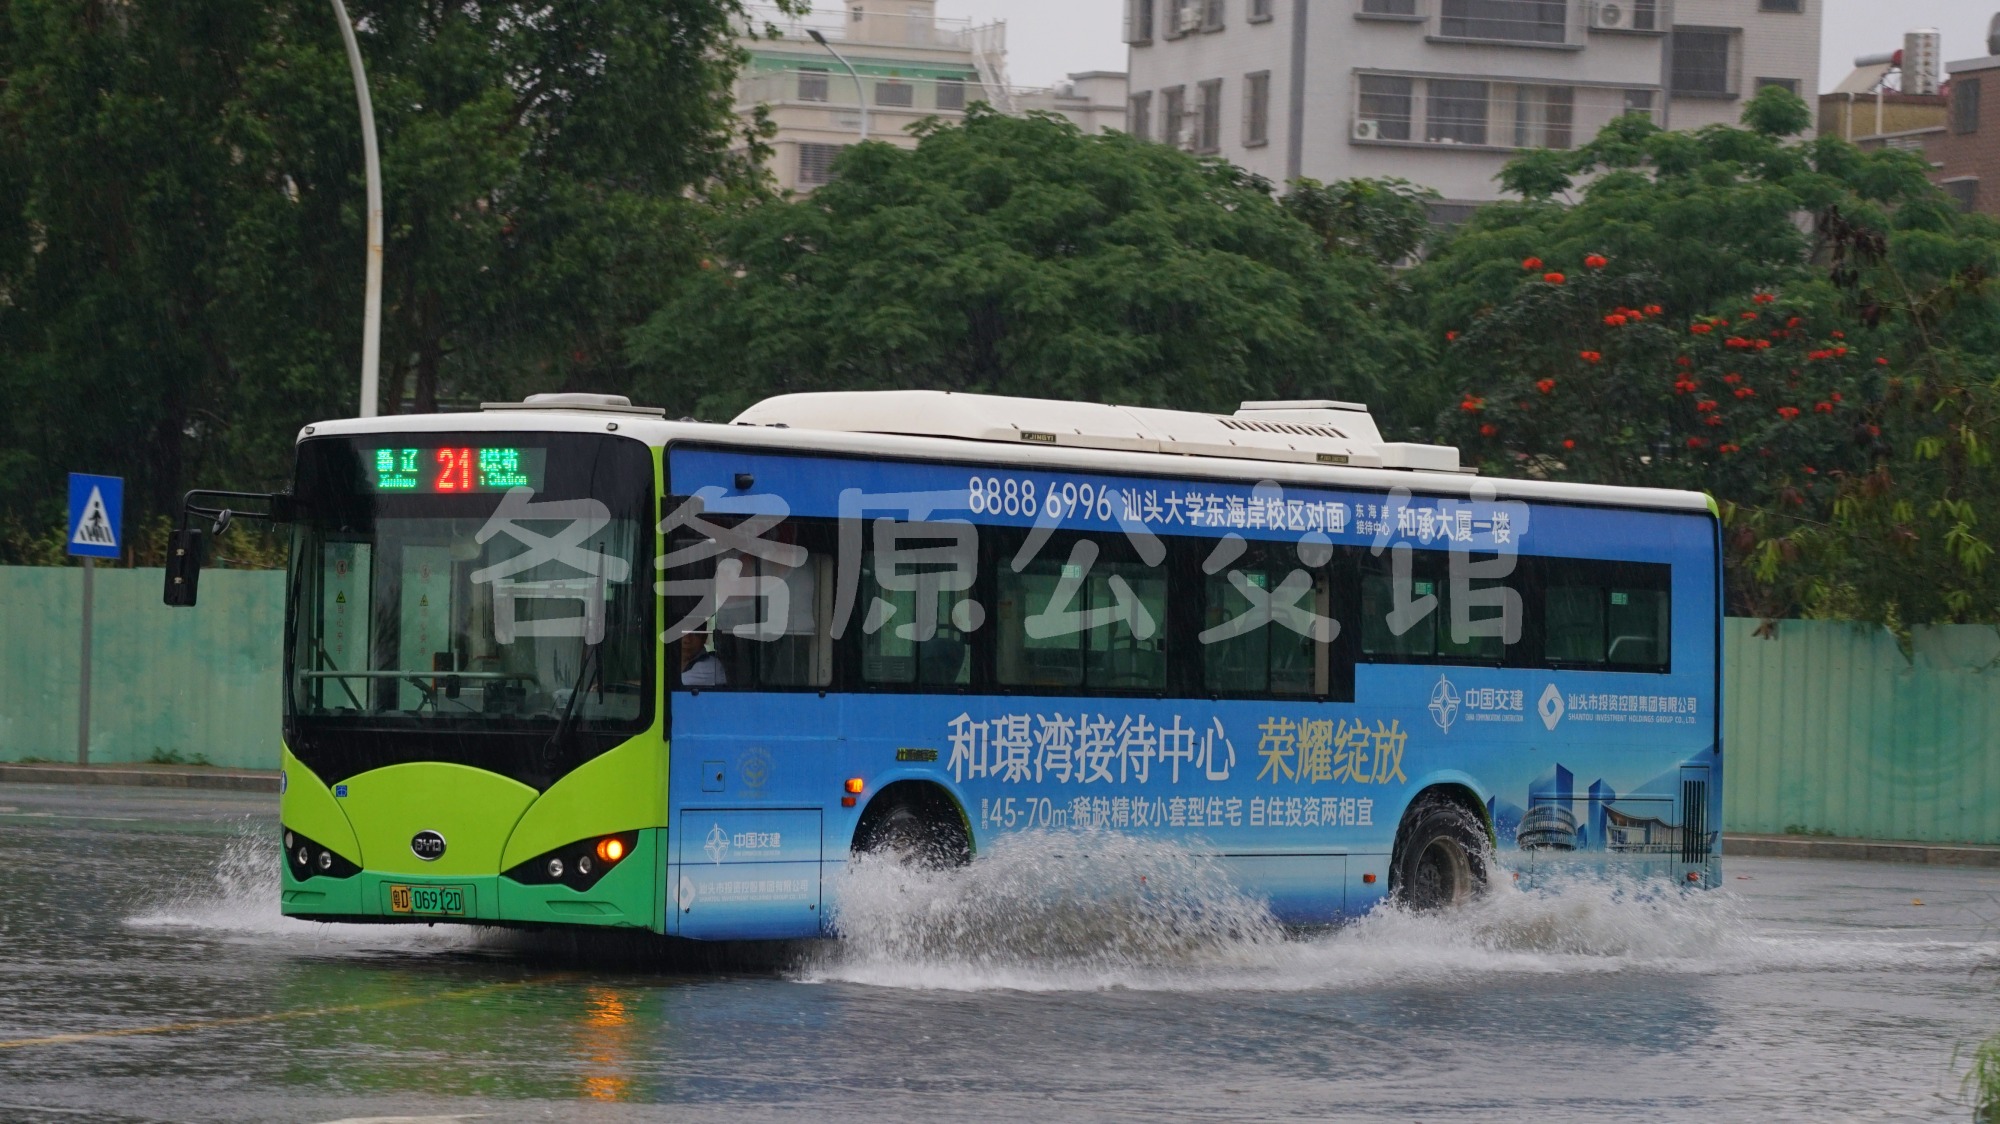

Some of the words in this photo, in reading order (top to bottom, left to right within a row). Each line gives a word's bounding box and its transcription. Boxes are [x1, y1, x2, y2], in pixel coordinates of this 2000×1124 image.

[438, 448, 471, 489] 21
[968, 476, 1038, 517] 8888
[1046, 481, 1113, 522] 6996
[1121, 487, 1346, 534] 汕头大学东海岸校区对面
[1355, 520, 1391, 536] 接待中心
[1397, 505, 1511, 544] 和承大厦一楼
[1465, 688, 1524, 711] 中国交建
[1568, 693, 1697, 714] 汕头市投资控股集团有限公司
[1568, 713, 1594, 721] SHANTOU
[1594, 714, 1627, 723] INVESTMENT
[1628, 715, 1655, 723] HOLDINGS
[1655, 715, 1674, 723] GROUP
[946, 712, 1236, 784] 和璟湾接待中心
[1256, 716, 1408, 785] 荣耀绽放
[1250, 796, 1374, 828] 自住投资两相宜
[414, 838, 442, 852] BYD
[733, 832, 781, 849] 中国交建
